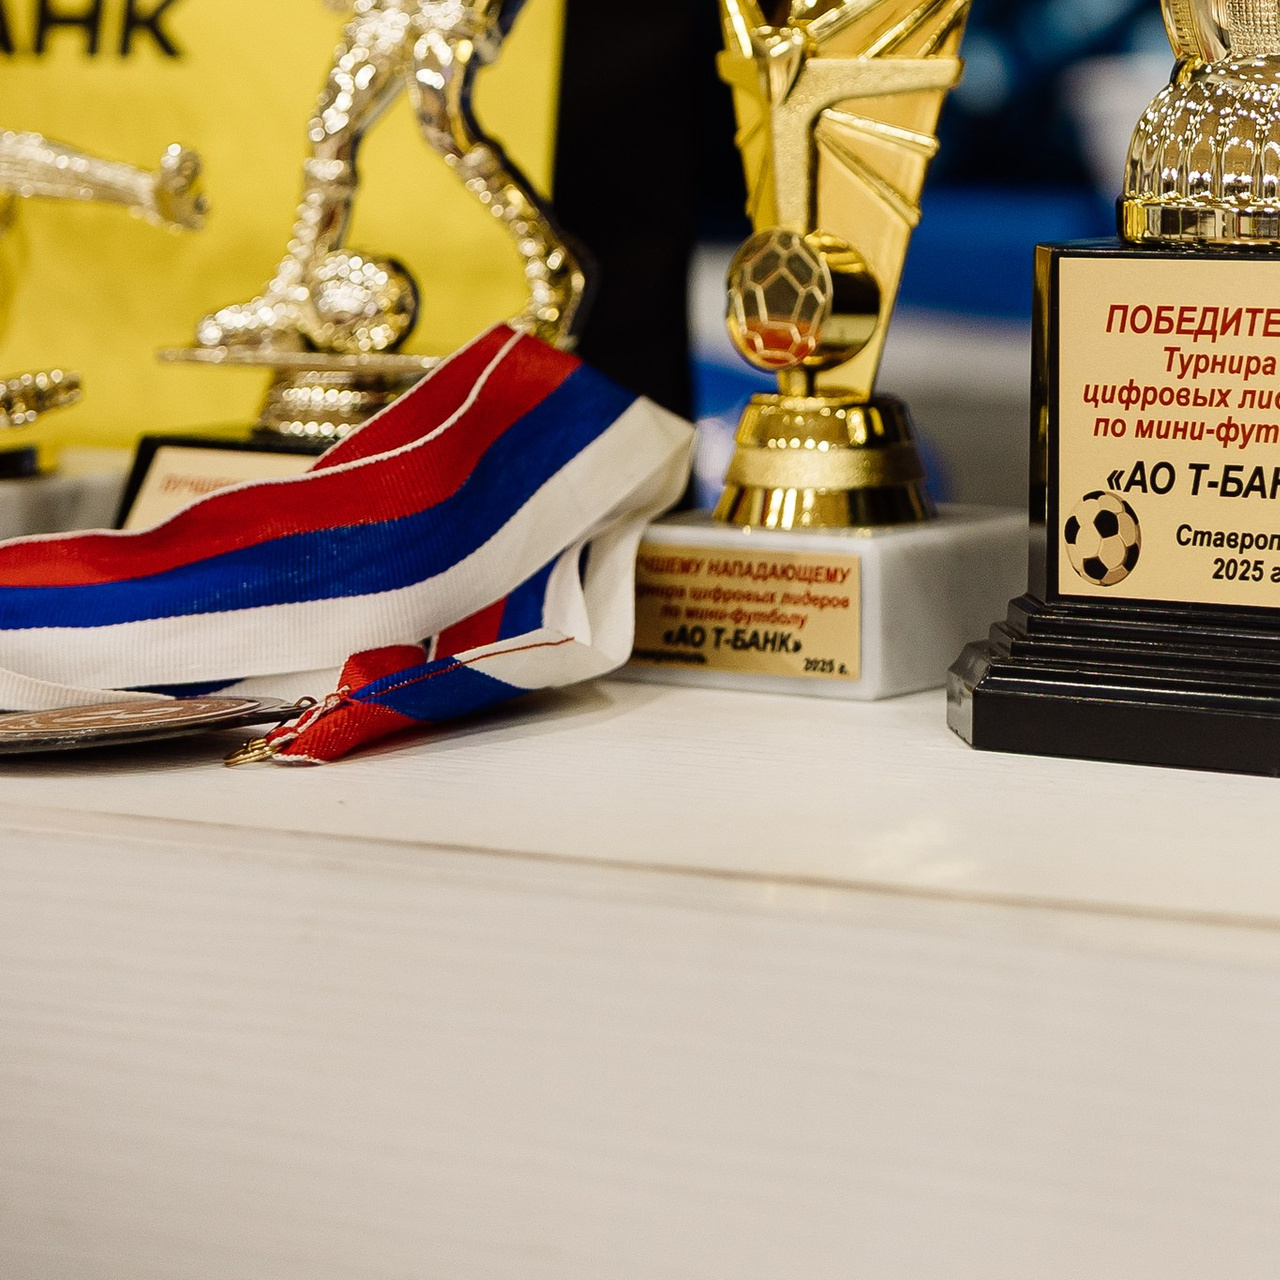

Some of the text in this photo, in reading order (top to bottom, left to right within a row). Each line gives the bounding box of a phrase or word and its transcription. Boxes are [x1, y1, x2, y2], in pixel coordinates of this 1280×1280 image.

[1164, 347, 1277, 380] Турнира
[1083, 379, 1230, 411] цифровых
[1093, 418, 1126, 438] по
[1106, 461, 1176, 493] «АО
[707, 560, 850, 584] НАПАДАЮЩЕМУ
[1212, 558, 1264, 581] 2025
